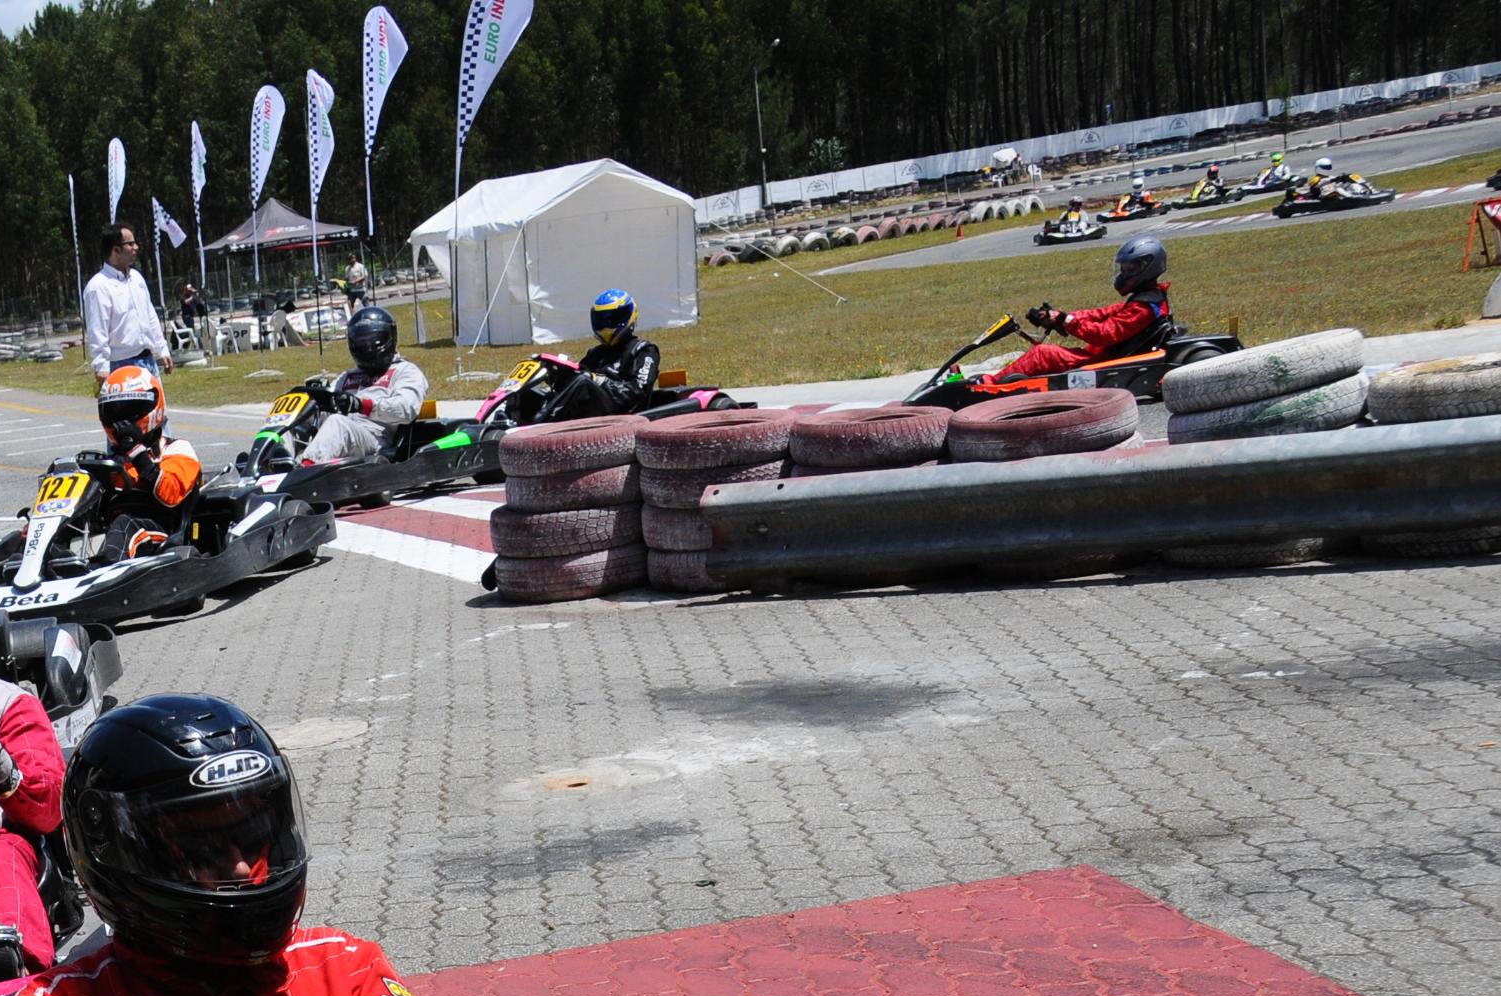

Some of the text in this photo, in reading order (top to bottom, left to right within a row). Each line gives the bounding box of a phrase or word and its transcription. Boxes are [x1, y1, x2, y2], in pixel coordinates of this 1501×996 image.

[484, 0, 506, 64] EURO IN
[379, 16, 387, 87] EURO INDY
[263, 121, 271, 152] EURO
[269, 396, 302, 414] 100
[39, 476, 79, 502] 127
[31, 522, 45, 546] Beta
[0, 592, 59, 608] Beta
[207, 755, 260, 781] HJC
